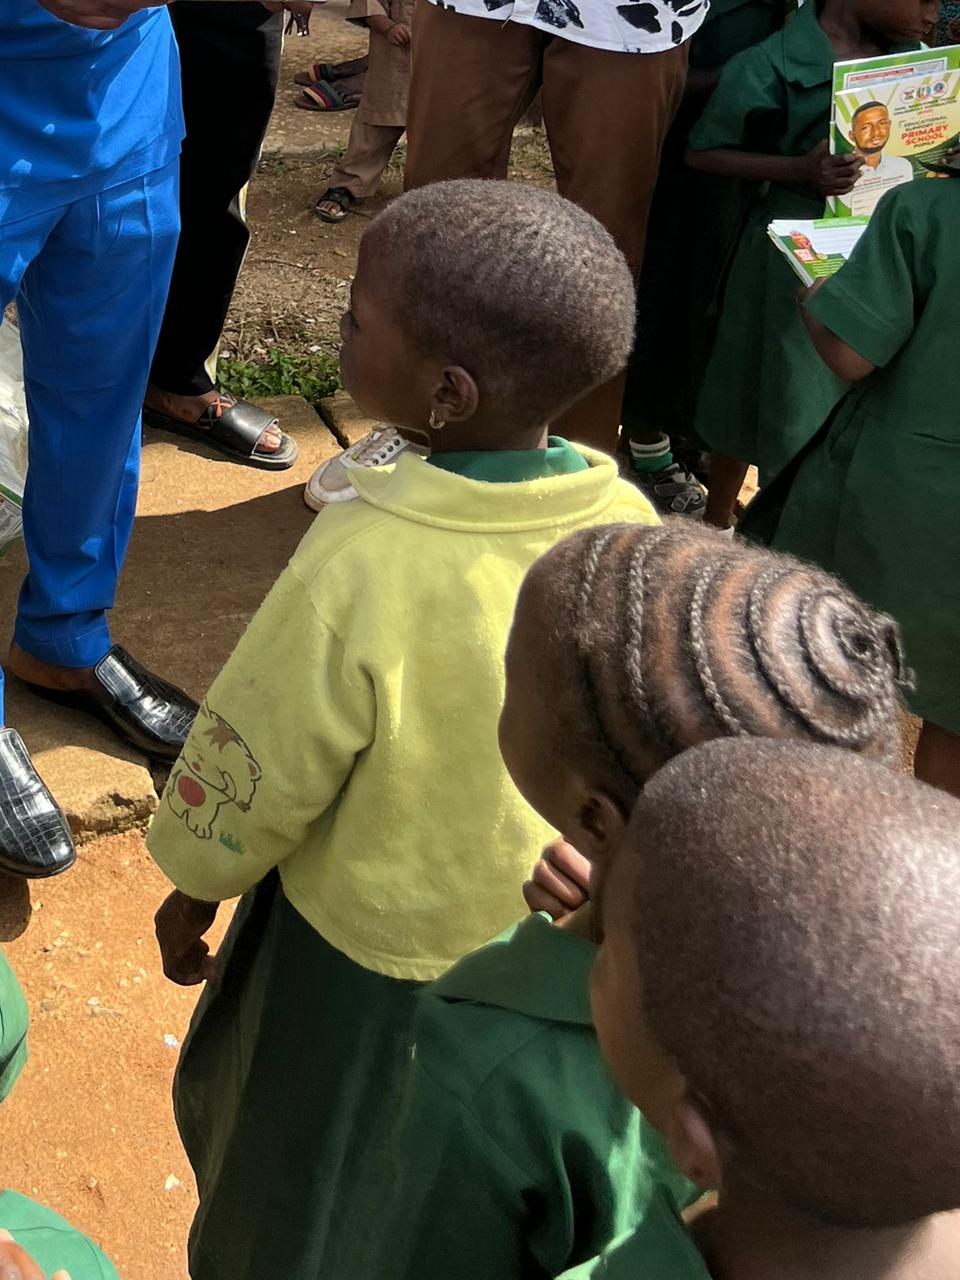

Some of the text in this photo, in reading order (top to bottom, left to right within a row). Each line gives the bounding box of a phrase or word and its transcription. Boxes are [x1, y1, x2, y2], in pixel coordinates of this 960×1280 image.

[904, 116, 947, 127] EDUCATIONAL
[901, 124, 948, 139] PRIMARY
[905, 133, 944, 145] SCHOOL
